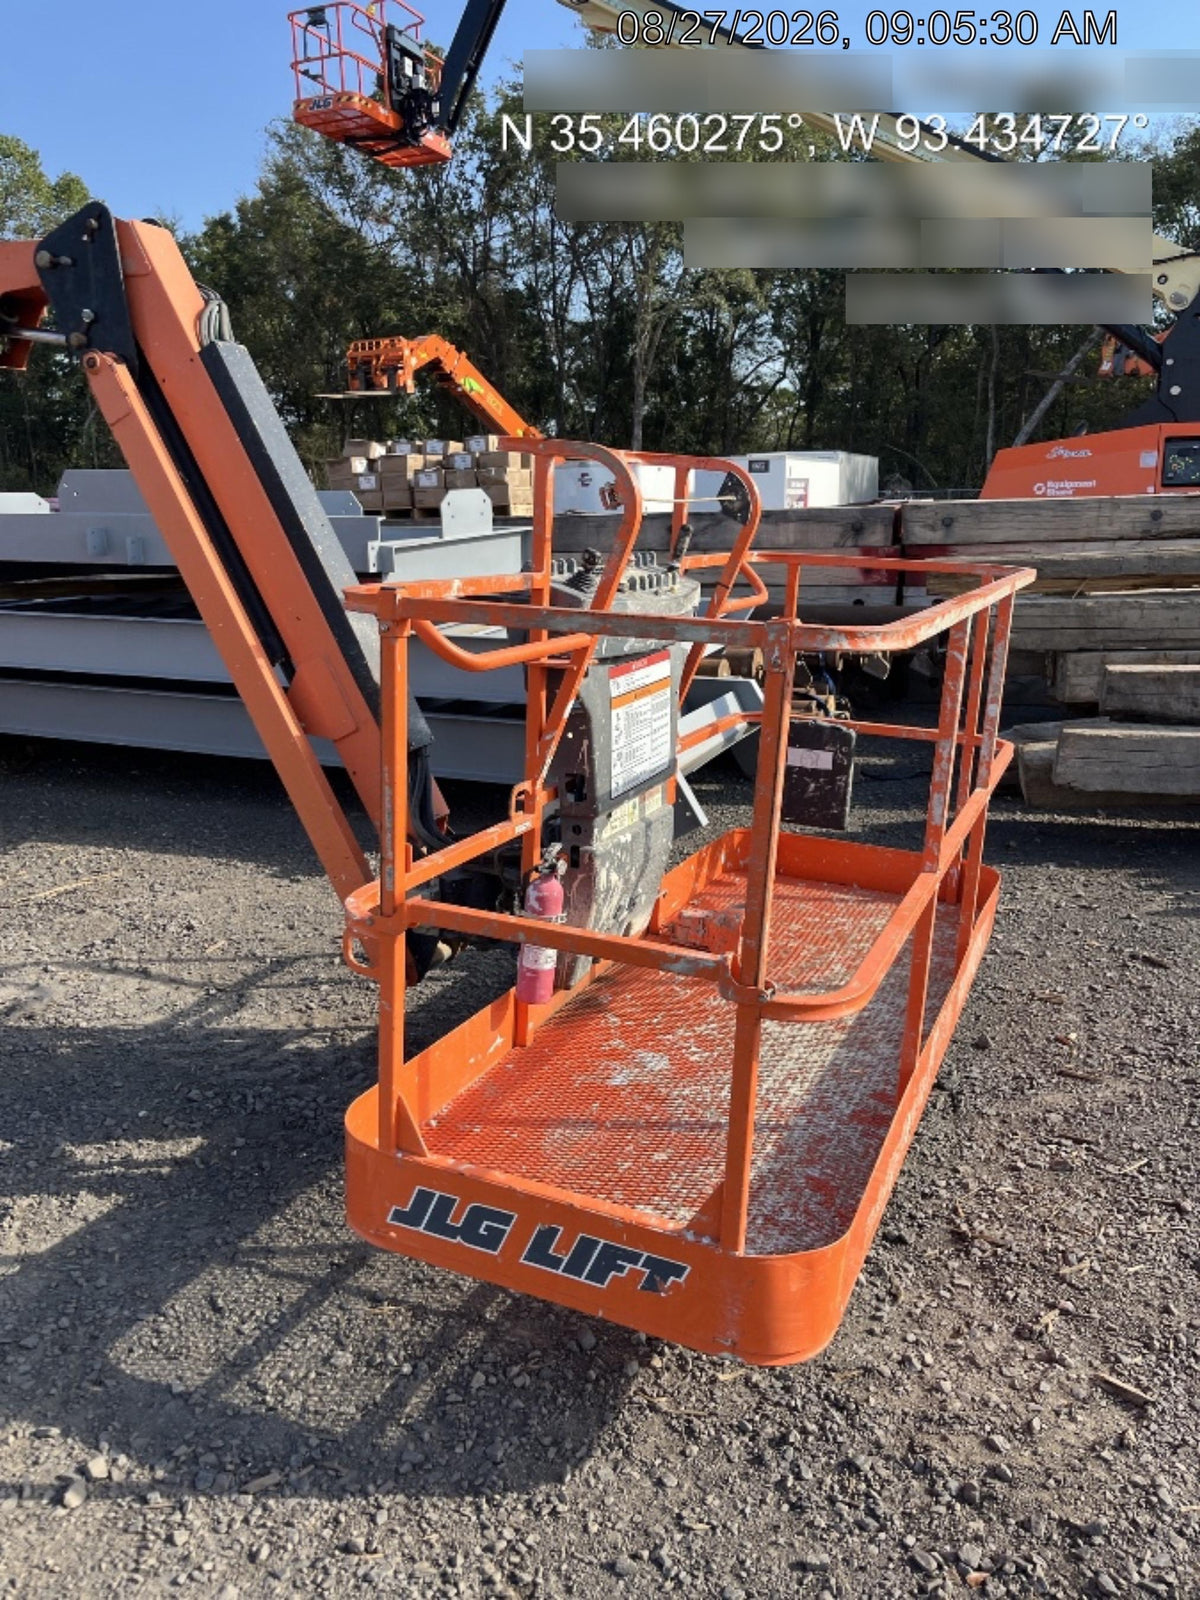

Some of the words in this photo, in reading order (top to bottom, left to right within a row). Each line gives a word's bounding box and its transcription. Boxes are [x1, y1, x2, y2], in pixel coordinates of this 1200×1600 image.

[308, 97, 333, 111] JLG
[386, 1185, 518, 1256] JLG
[520, 1224, 692, 1297] LIFT
